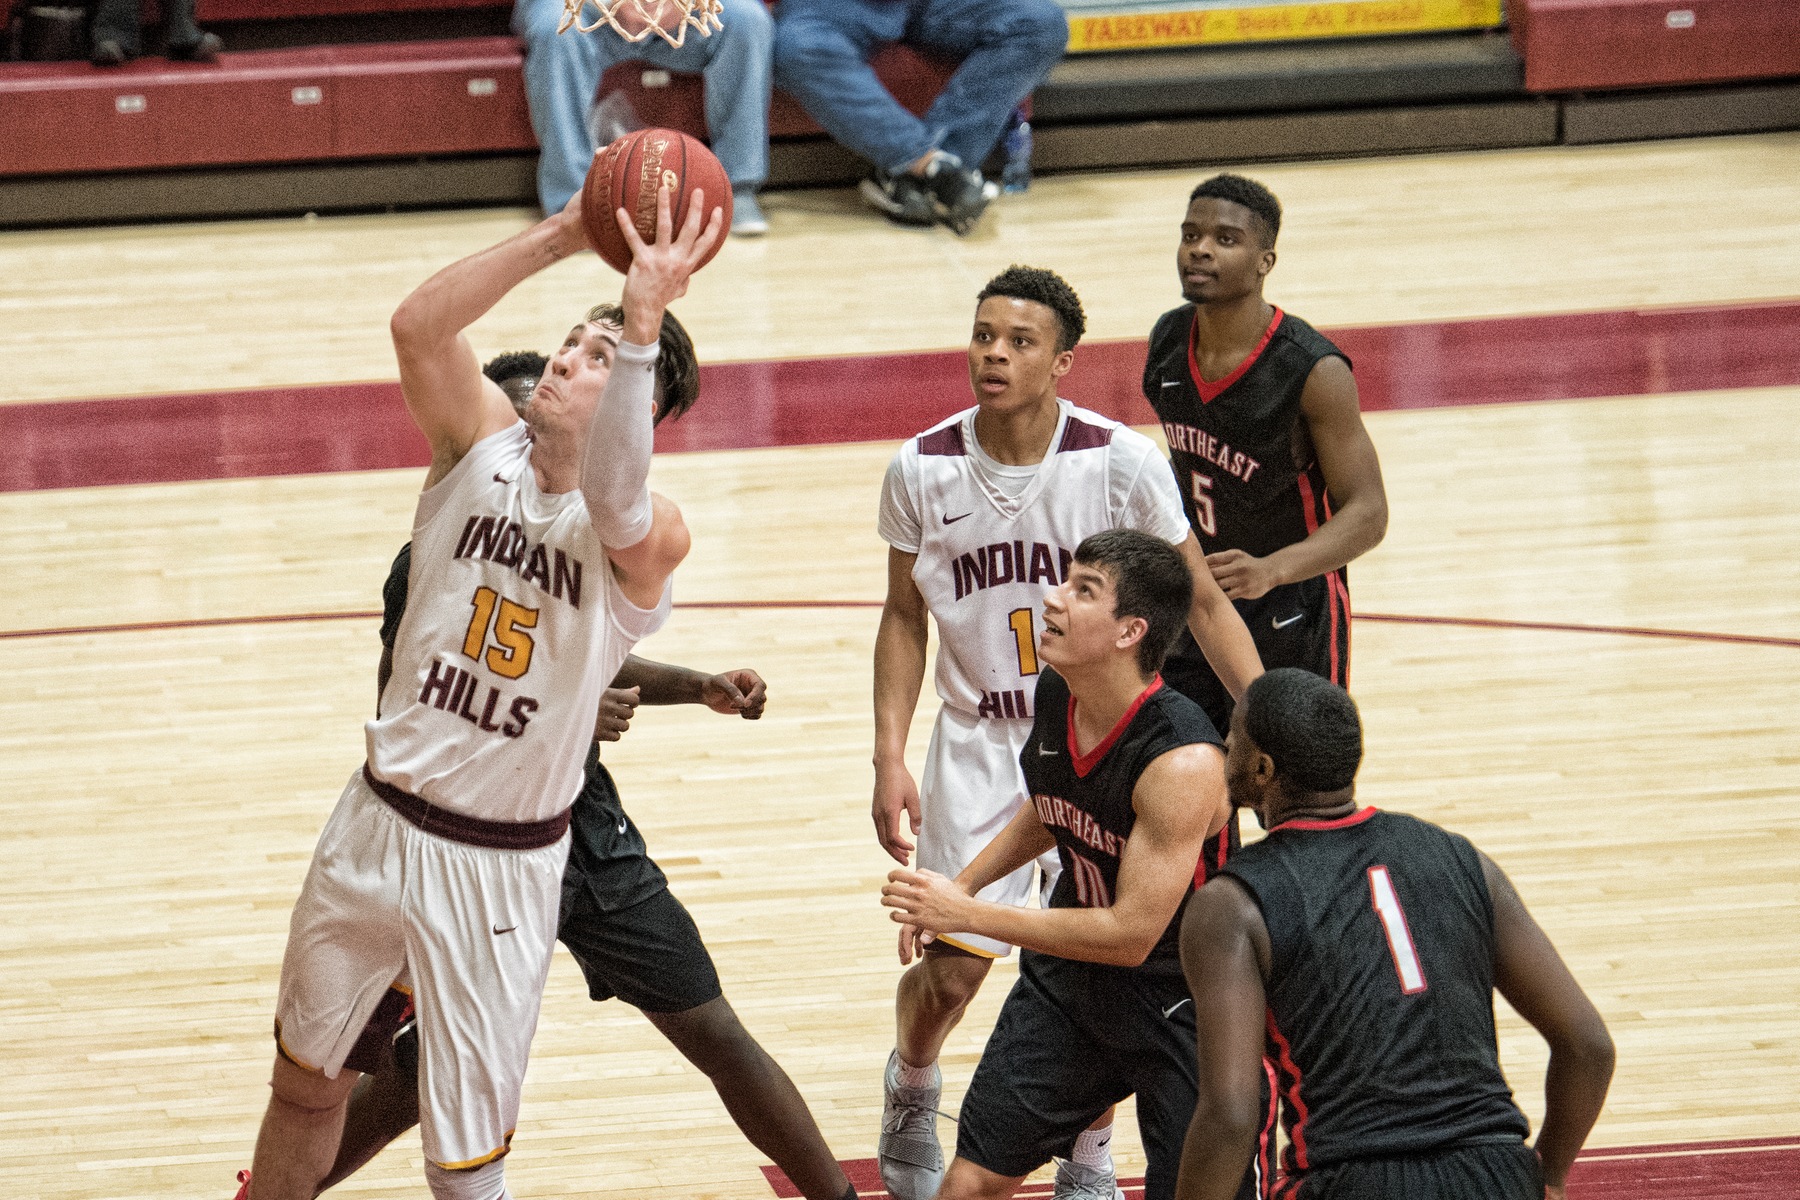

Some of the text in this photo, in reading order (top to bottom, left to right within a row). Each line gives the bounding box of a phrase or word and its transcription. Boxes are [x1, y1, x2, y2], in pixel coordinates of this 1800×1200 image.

[1083, 12, 1208, 42] FAREWAY
[1164, 422, 1260, 483] ORTHEAST
[1191, 470, 1217, 537] 5
[453, 515, 582, 610] INDIAN
[462, 585, 540, 680] 15
[1007, 607, 1039, 677] 1
[418, 655, 539, 739] HILLS
[1366, 864, 1428, 995] 1
